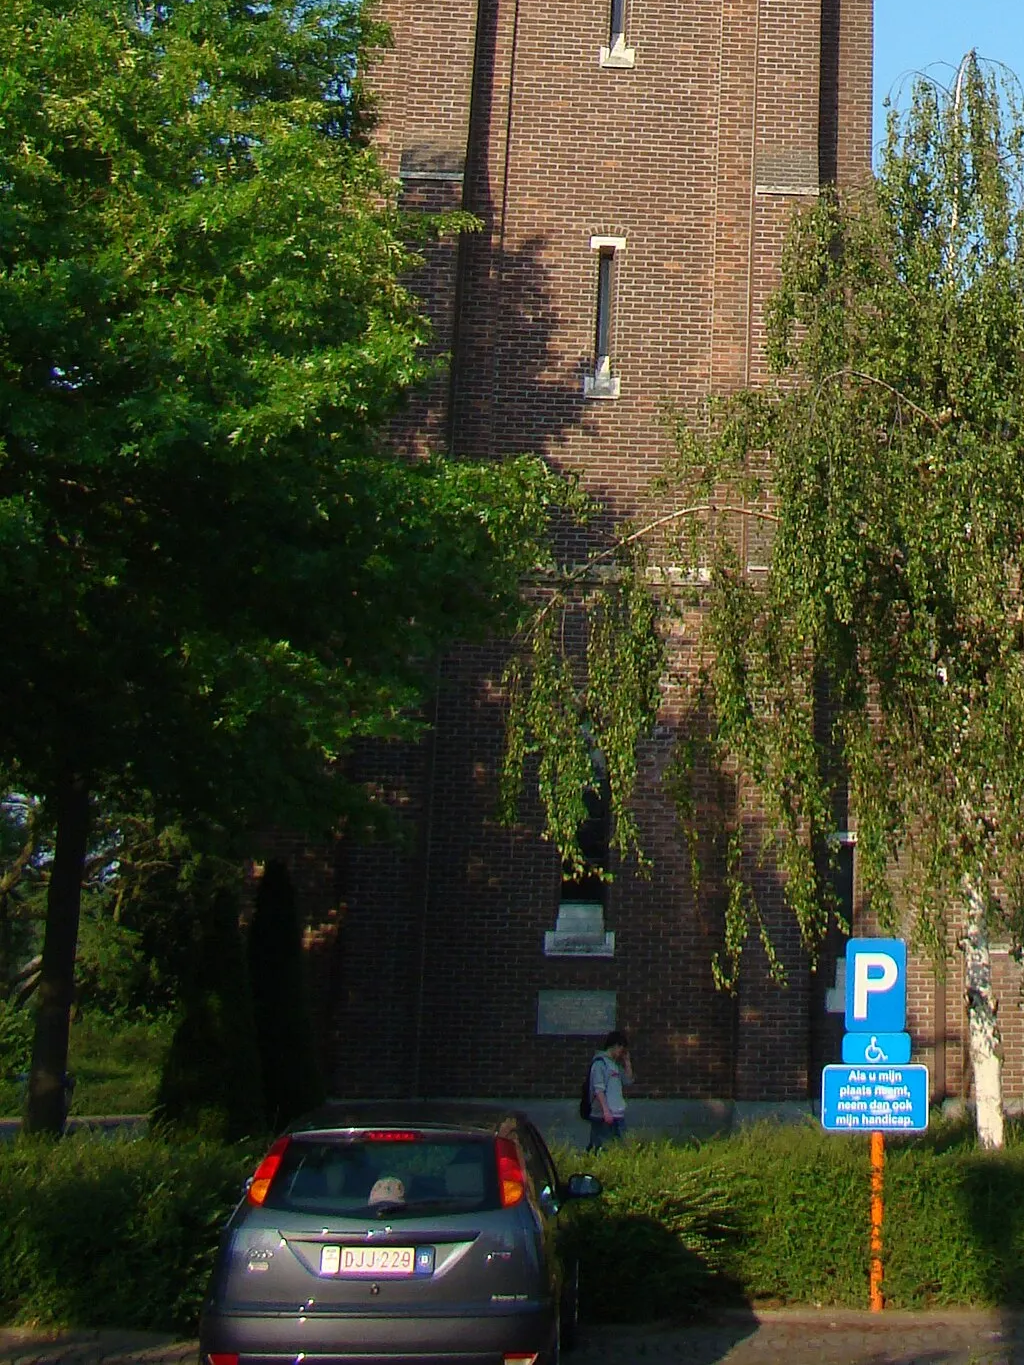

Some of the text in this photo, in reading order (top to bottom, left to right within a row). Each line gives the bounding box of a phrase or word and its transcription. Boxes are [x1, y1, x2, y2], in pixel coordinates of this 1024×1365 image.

[853, 952, 898, 1020] P
[849, 1070, 902, 1084] Als u mijn
[839, 1085, 911, 1097] plaats neemt,
[838, 1100, 912, 1111] neem dan ook
[836, 1114, 914, 1126] mijn handicap.
